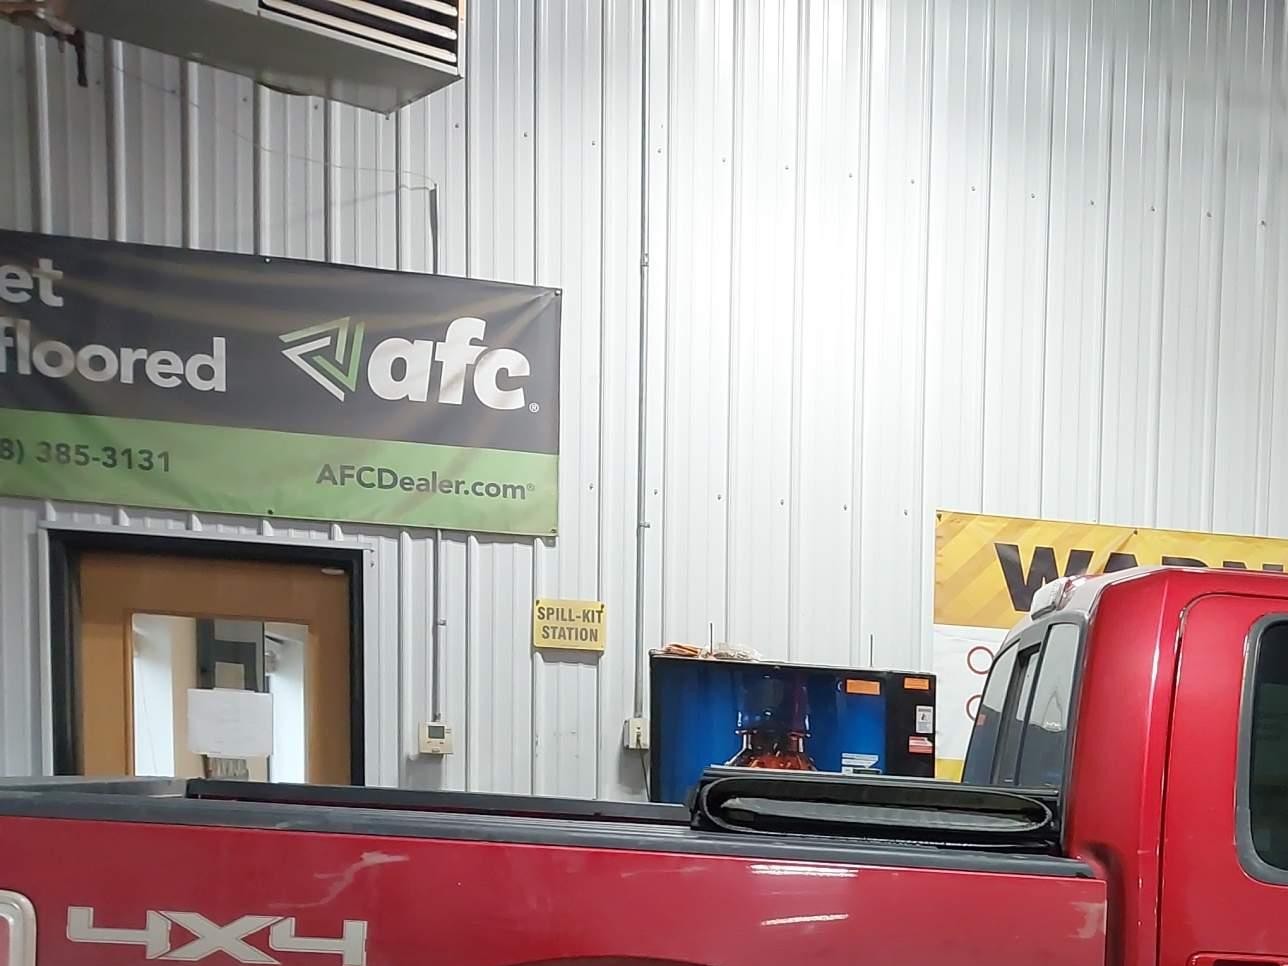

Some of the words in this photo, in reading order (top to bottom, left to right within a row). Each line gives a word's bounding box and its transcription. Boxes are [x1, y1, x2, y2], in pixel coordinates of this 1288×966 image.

[36, 440, 170, 472] 385-3131
[537, 606, 603, 624] SPILL-KIT
[542, 625, 598, 642] STATION
